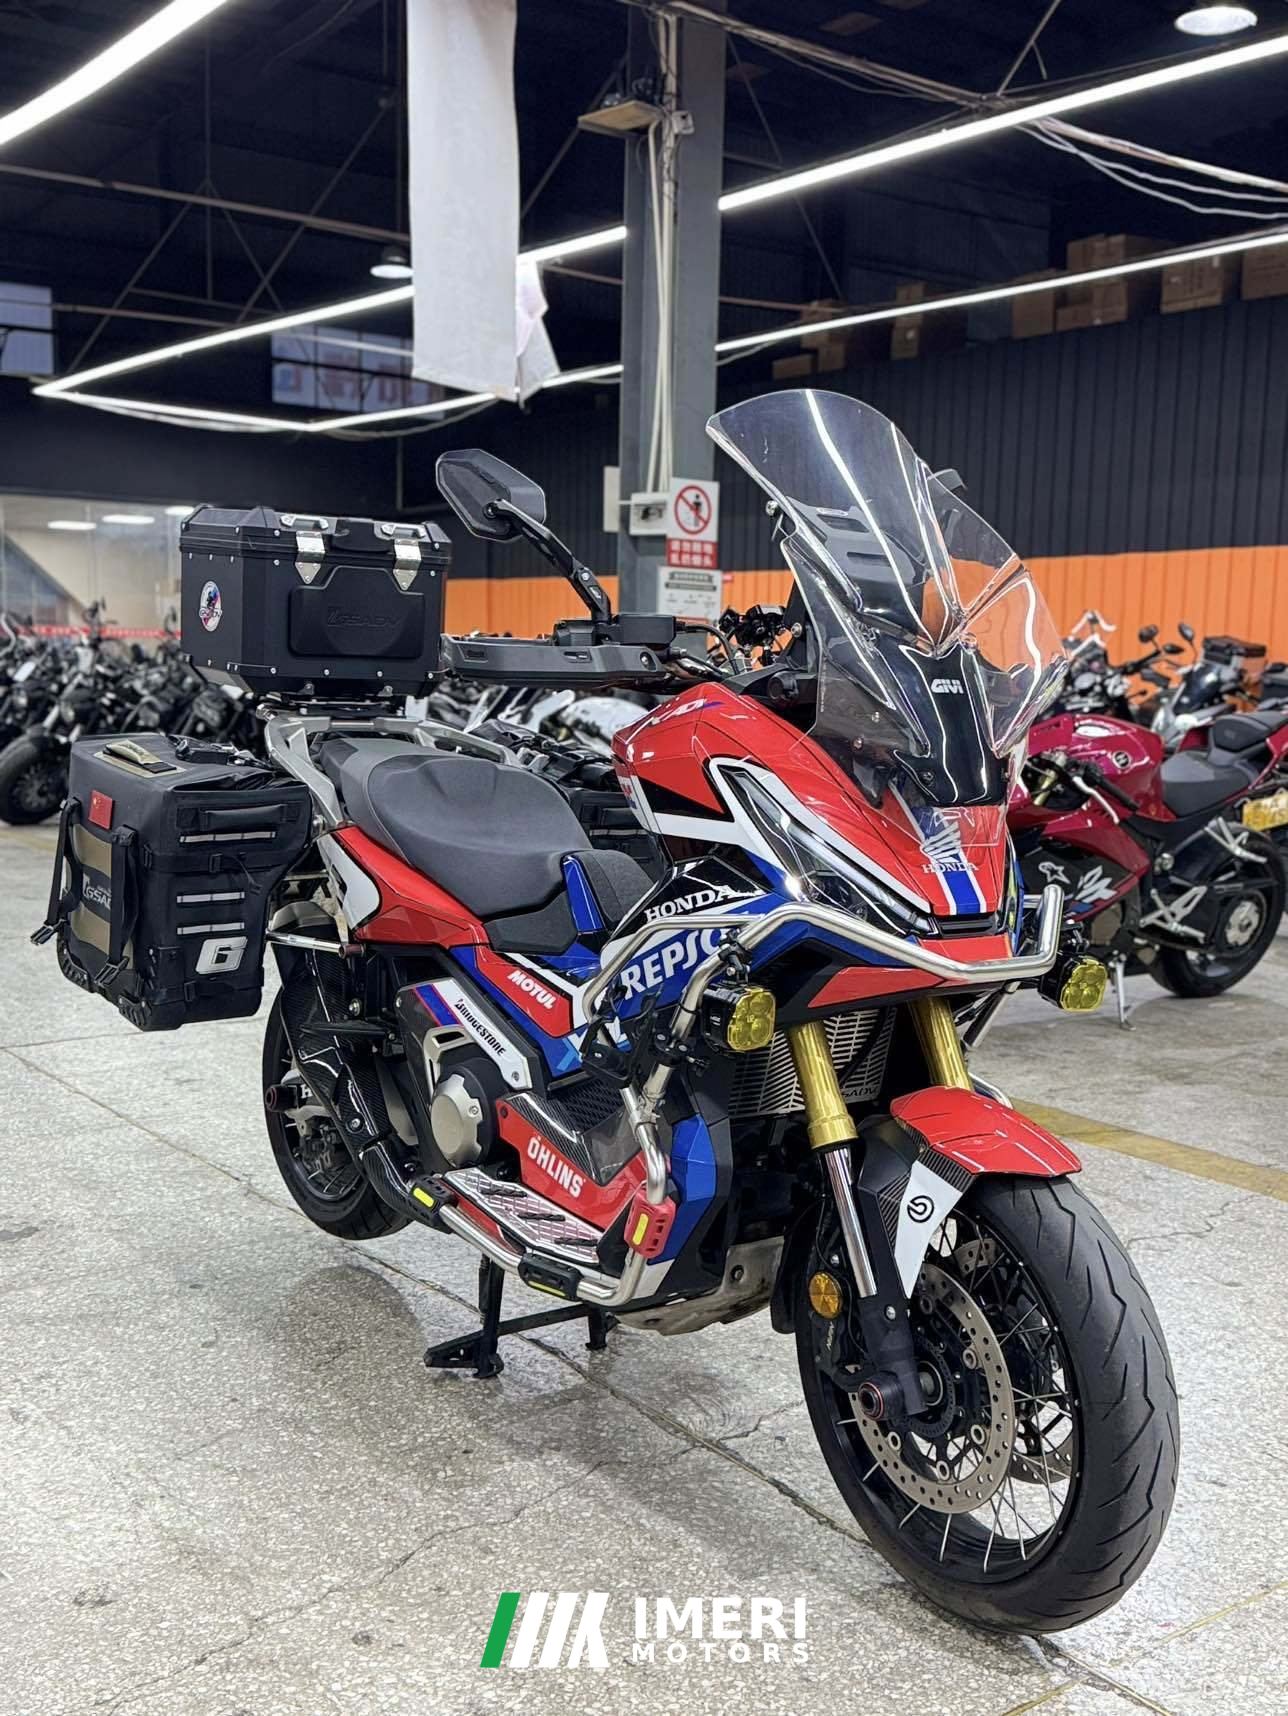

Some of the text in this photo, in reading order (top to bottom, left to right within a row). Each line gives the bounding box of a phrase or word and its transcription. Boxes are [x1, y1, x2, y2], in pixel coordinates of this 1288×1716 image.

[921, 863, 979, 873] HONDA
[643, 885, 740, 922] HONDA
[507, 969, 557, 1009] MOTUL
[454, 998, 506, 1056] BRIDGESTONE
